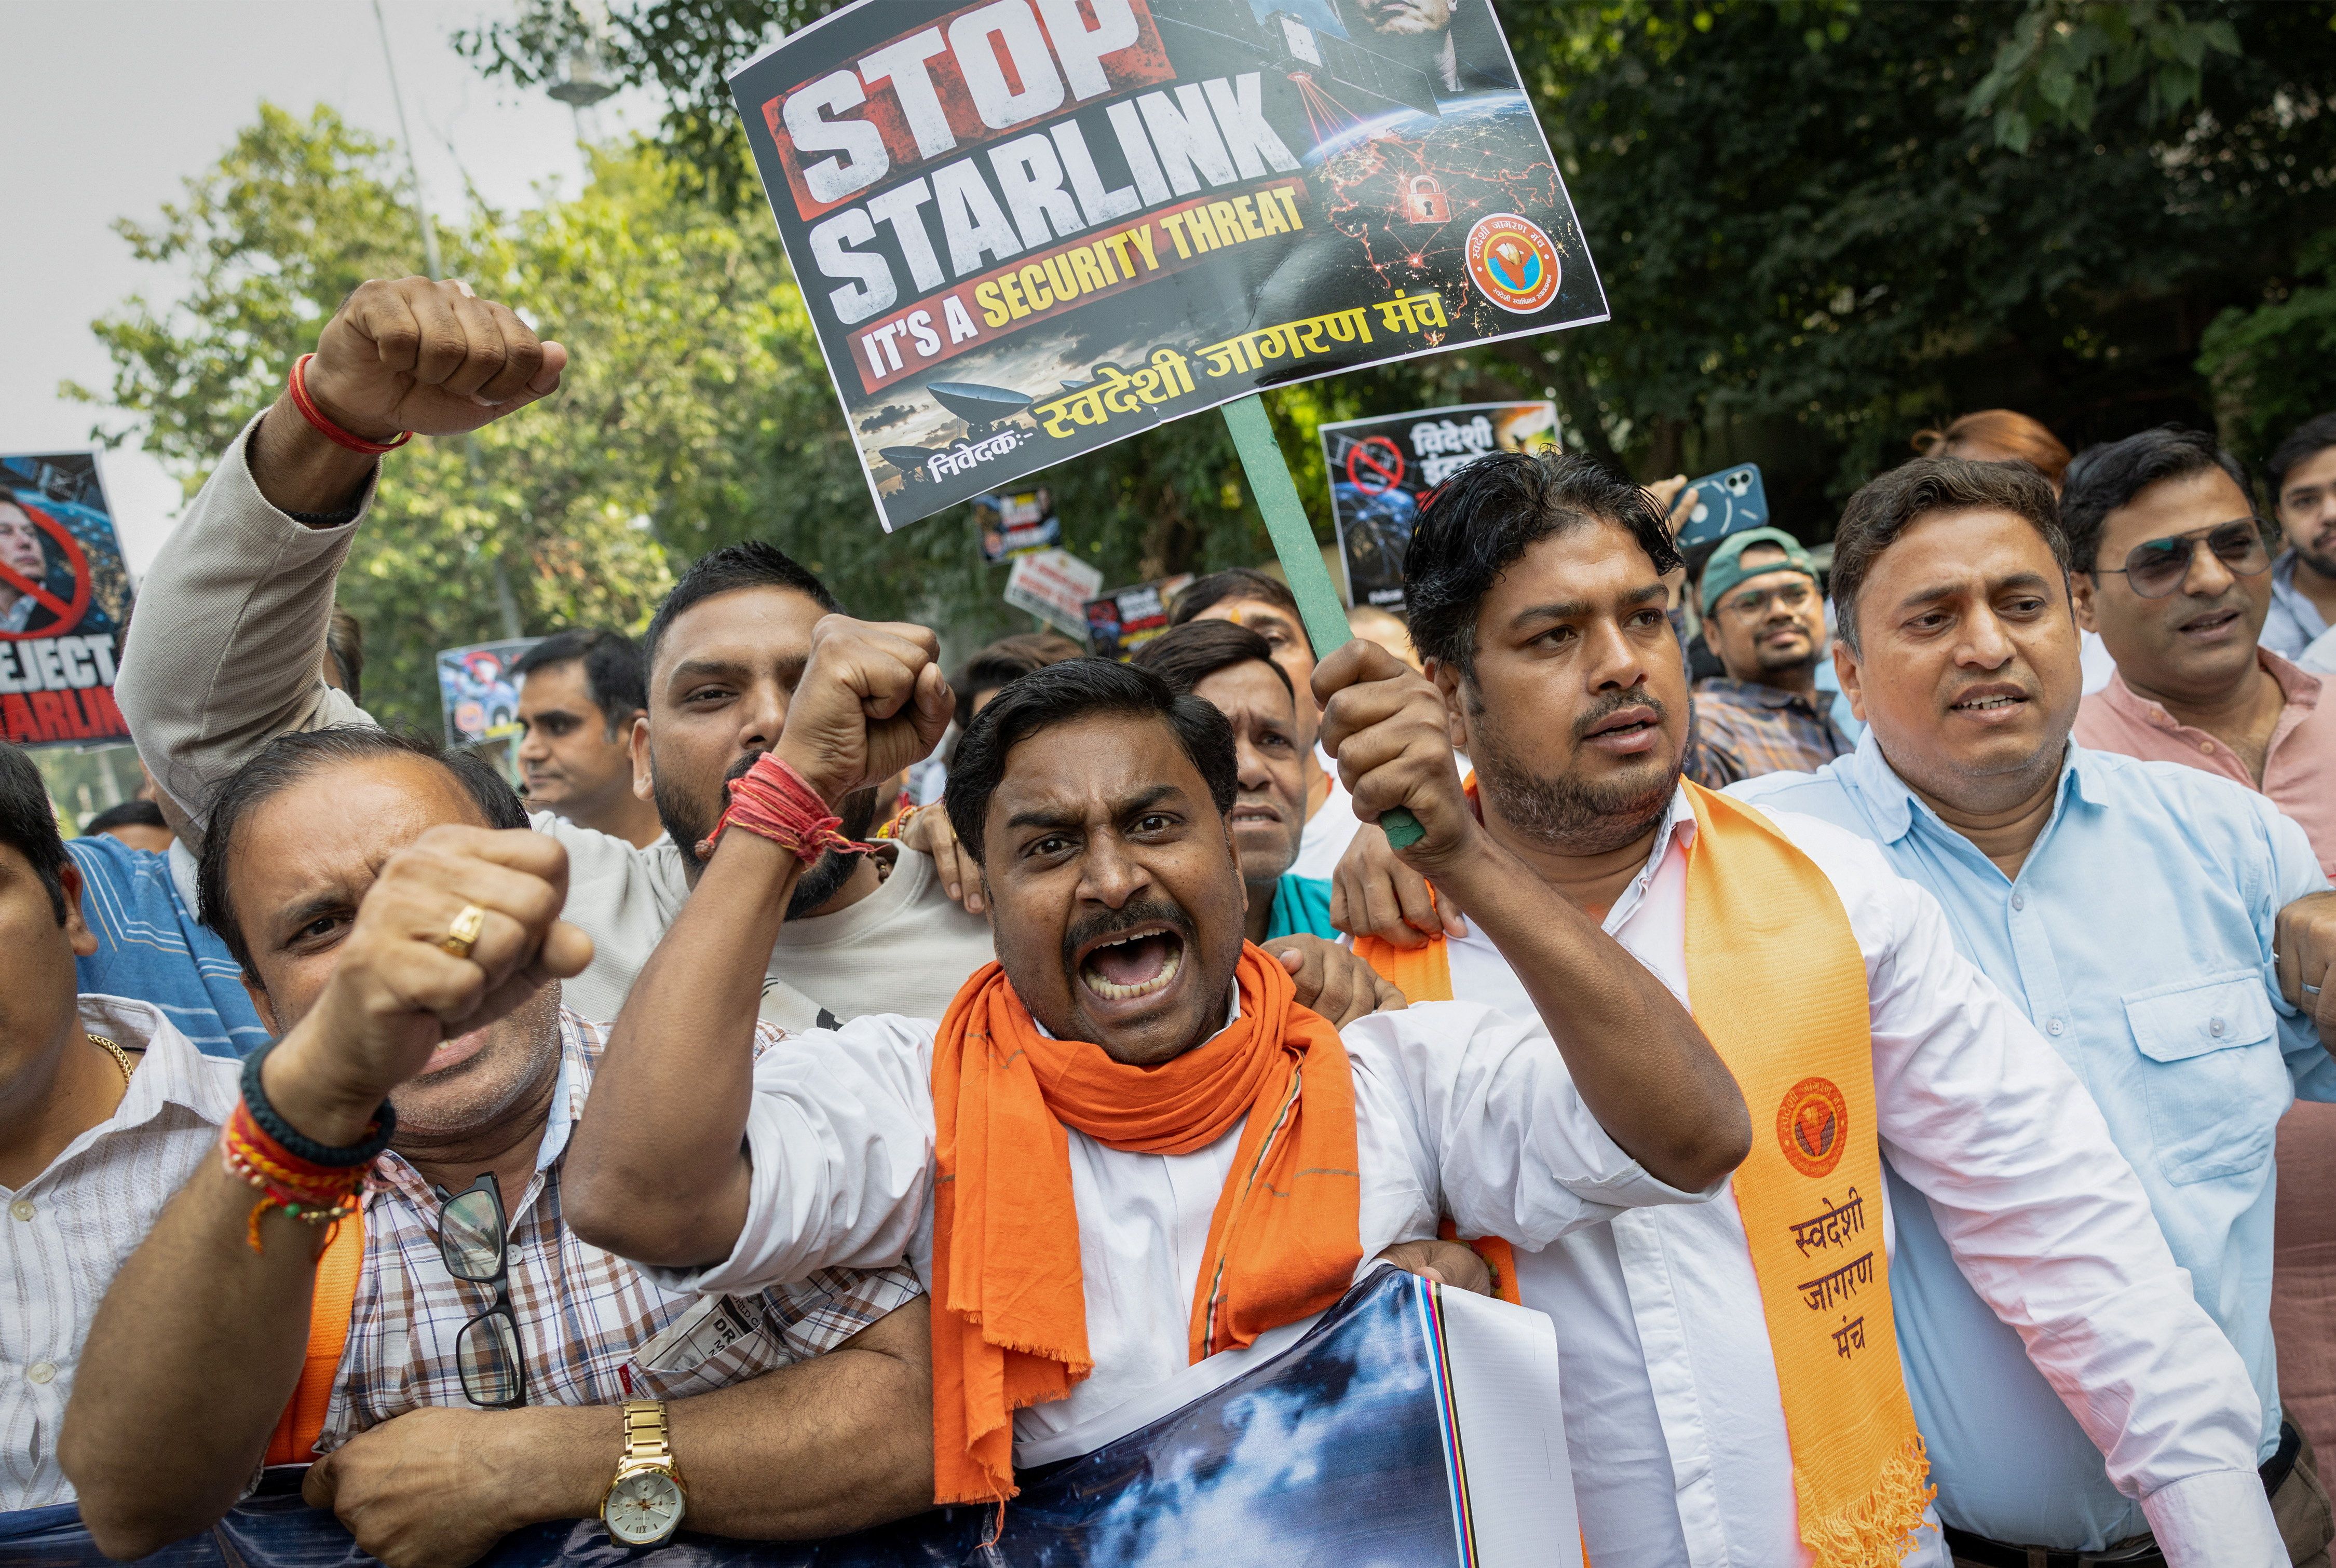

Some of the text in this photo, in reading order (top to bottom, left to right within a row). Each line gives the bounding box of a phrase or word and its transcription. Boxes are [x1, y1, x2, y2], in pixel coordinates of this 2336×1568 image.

[783, 0, 1139, 203] STOP
[809, 72, 1302, 324] STARLINK
[1472, 221, 1545, 259] स्वदेशी जागरण मंच
[860, 186, 1303, 378] IT'S A SECURITY THREAT
[1493, 287, 1511, 302] स्वदेशी
[1034, 348, 1196, 439] स्वदेशी
[1195, 307, 1373, 377] जागरण
[1373, 289, 1448, 334] मंच
[1409, 415, 1495, 457] विदेशी
[1789, 1186, 1866, 1258] स्वदेशी
[1798, 1251, 1873, 1312] जागरण
[1831, 1314, 1866, 1360] मंच
